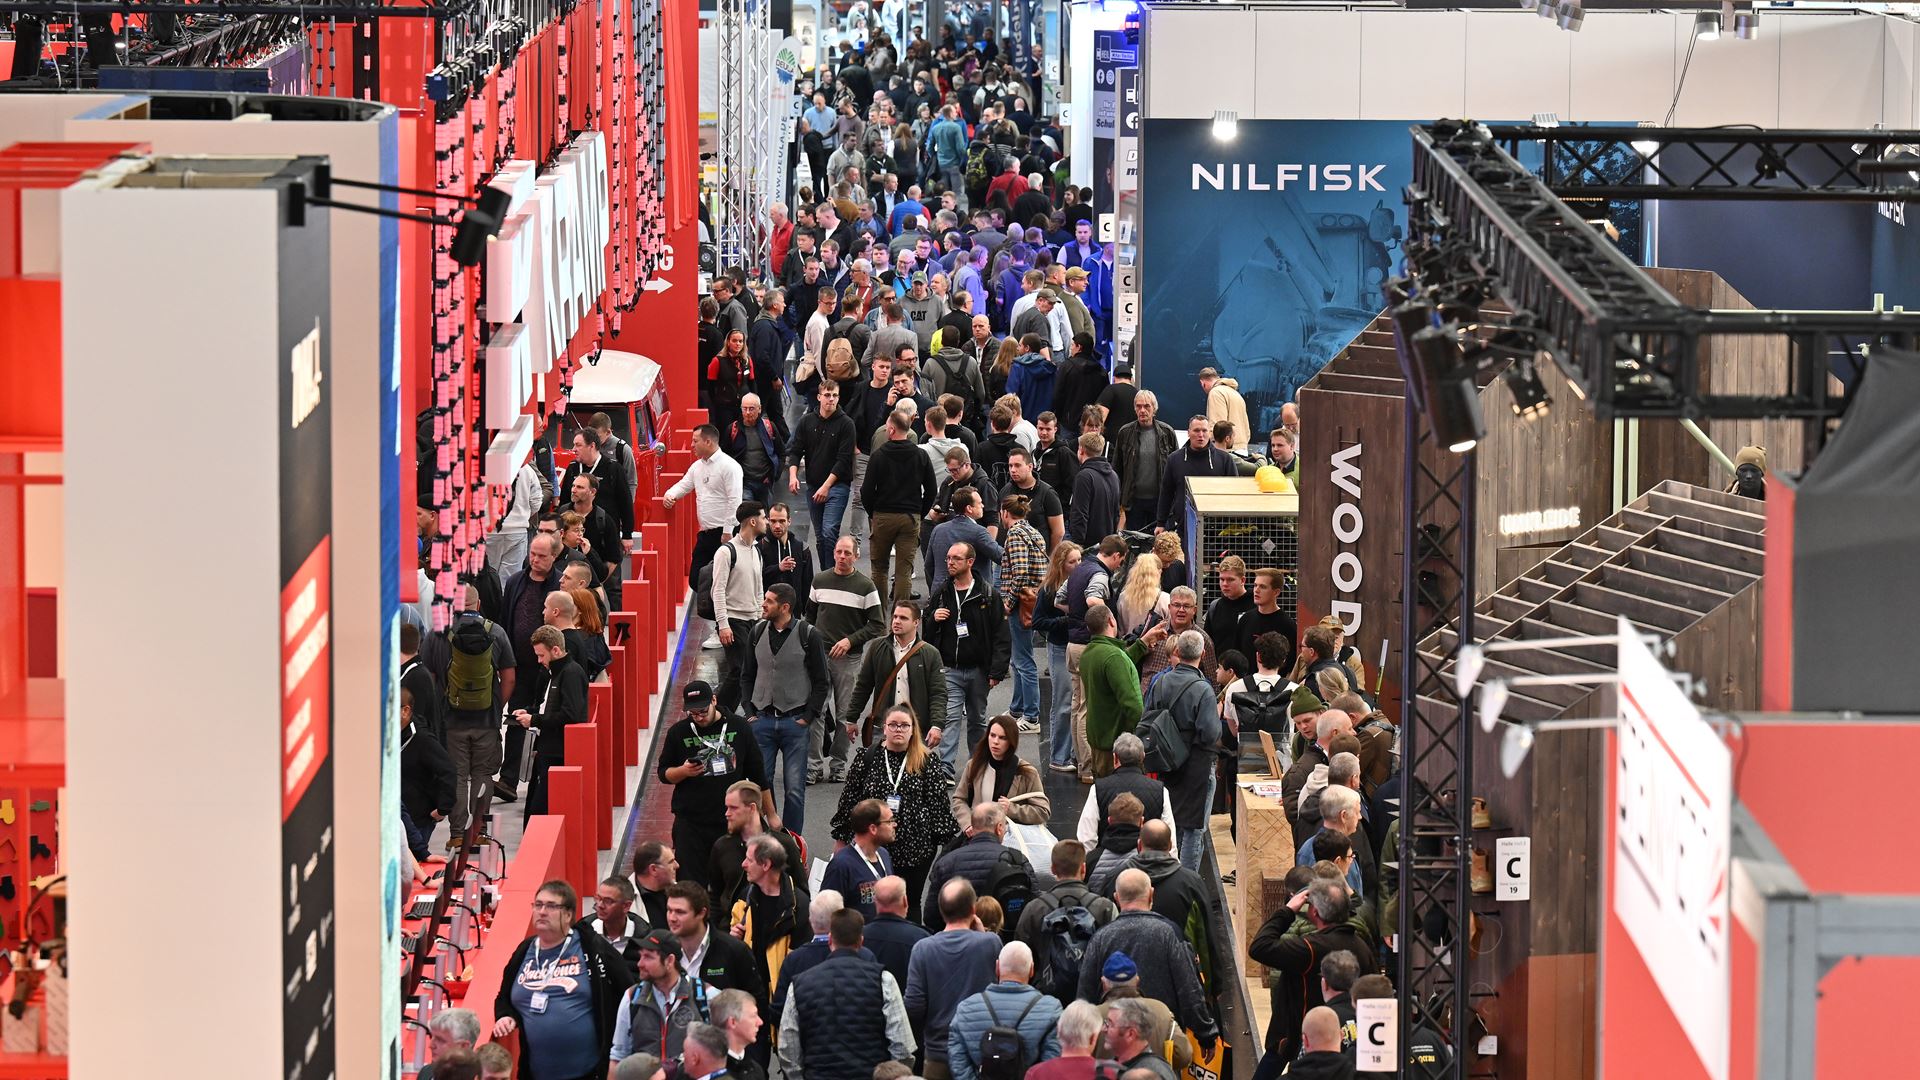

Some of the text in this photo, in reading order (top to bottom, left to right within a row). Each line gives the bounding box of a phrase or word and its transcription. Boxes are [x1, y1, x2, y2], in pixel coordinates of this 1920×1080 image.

[1191, 163, 1387, 192] NILFISK
[1878, 200, 1906, 227] NILFISK
[1103, 222, 1111, 233] C
[1122, 275, 1132, 287] C
[1124, 302, 1133, 314] C
[910, 310, 928, 322] CAT
[1506, 856, 1522, 879] C
[1509, 886, 1519, 894] 19
[1367, 1021, 1386, 1046] C
[1371, 1055, 1382, 1064] 18
